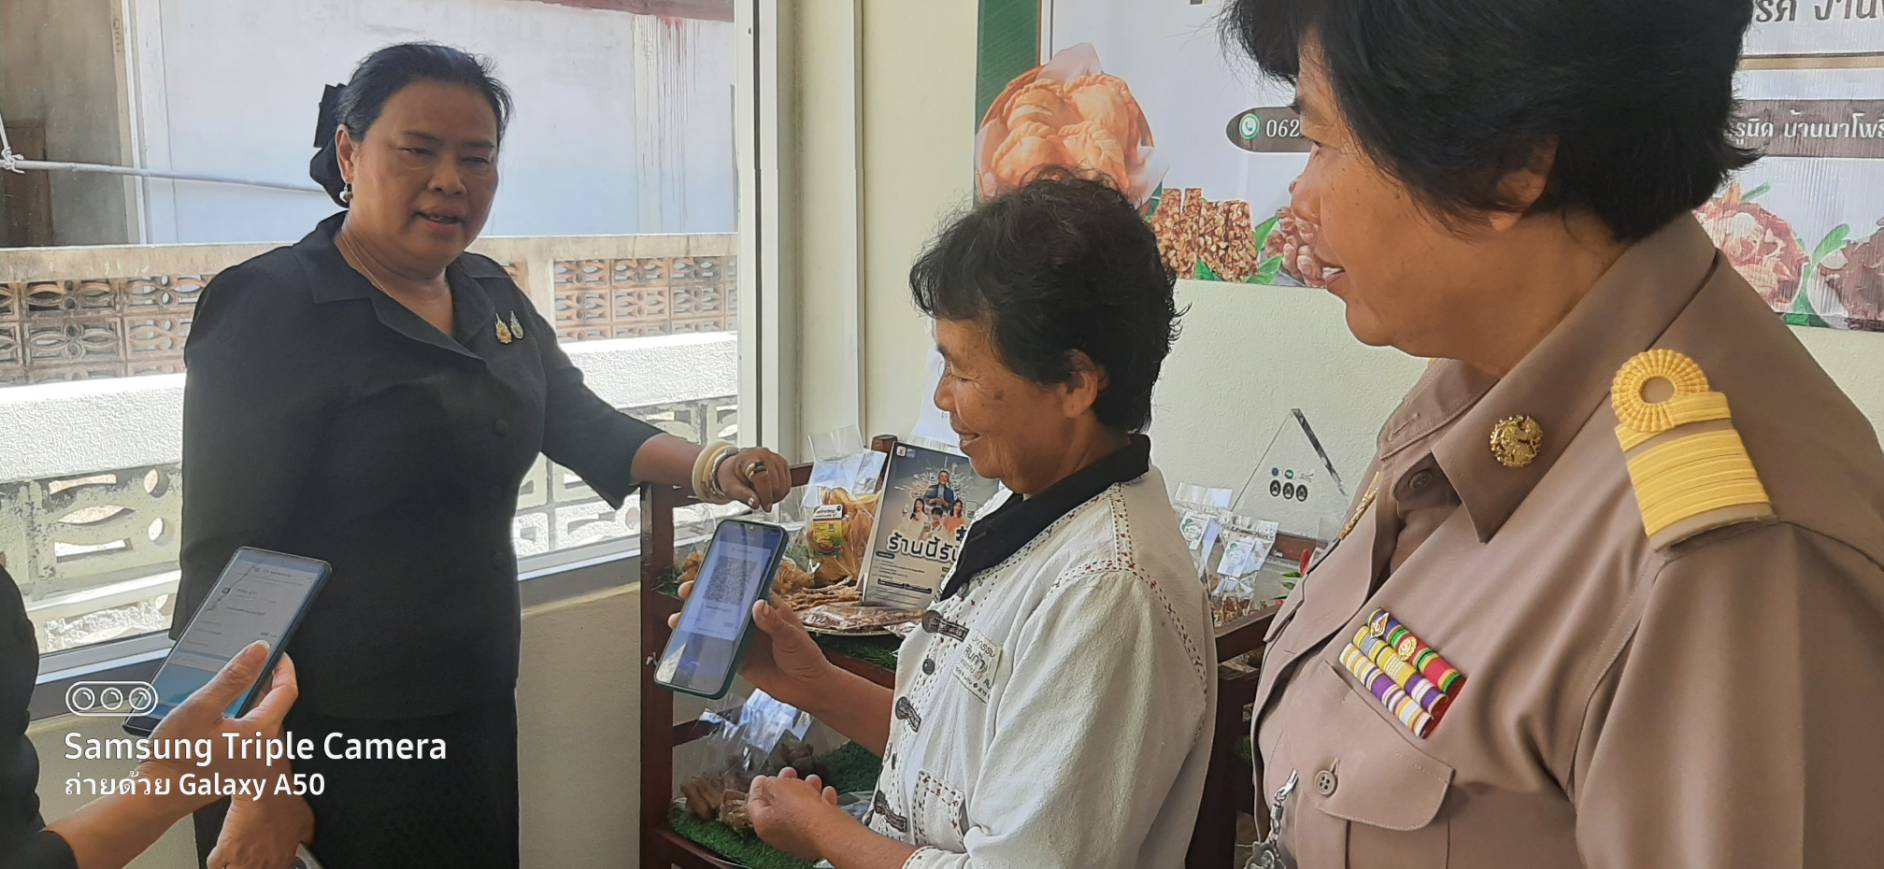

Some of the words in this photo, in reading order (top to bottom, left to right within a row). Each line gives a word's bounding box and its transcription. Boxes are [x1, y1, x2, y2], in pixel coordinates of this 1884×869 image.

[1814, 0, 1884, 20] งาน
[1265, 119, 1300, 137] 062
[1724, 117, 1774, 146] รูนิด
